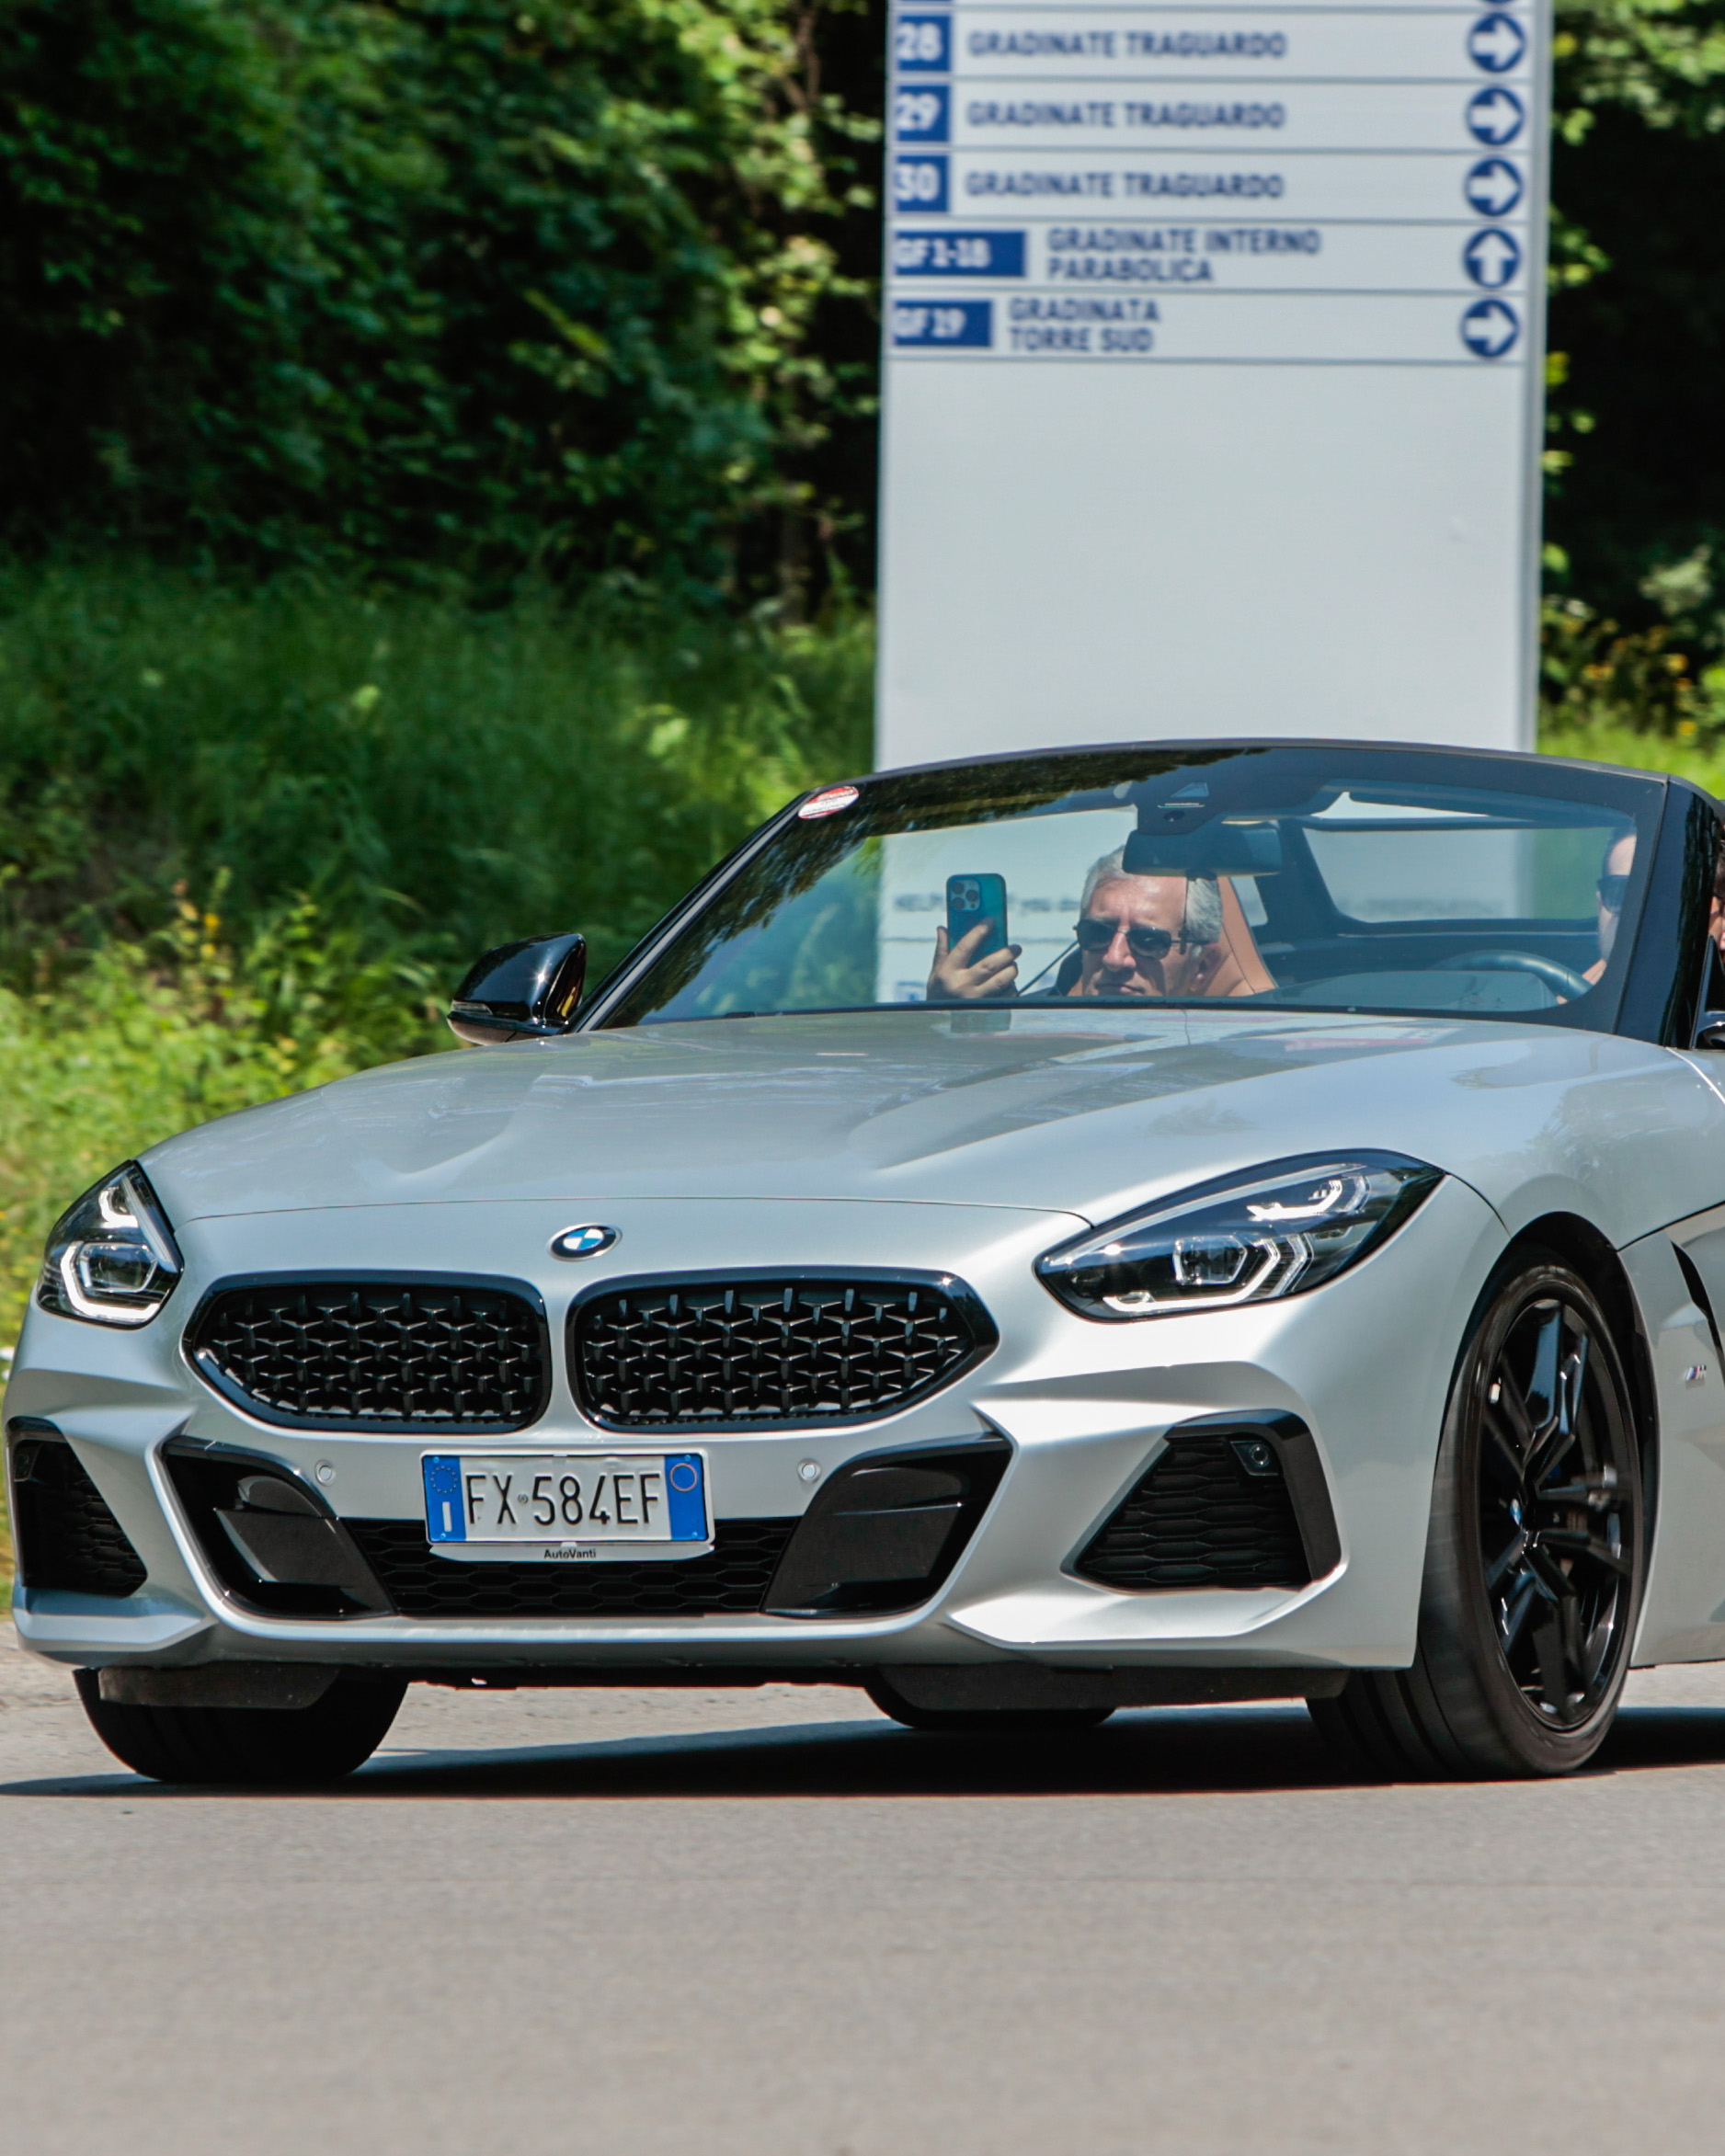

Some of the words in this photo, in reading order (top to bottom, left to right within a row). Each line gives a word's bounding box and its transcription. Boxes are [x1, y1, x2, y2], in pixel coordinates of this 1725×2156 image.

[896, 22, 942, 61] 28
[968, 31, 1116, 58] GRADINATE
[1125, 31, 1287, 59] TRAGUARDO
[896, 94, 941, 131] 29
[968, 101, 1115, 128] GRADINATE
[1124, 101, 1285, 129] TRAGUARDO
[895, 164, 940, 201] 30
[965, 171, 1114, 198] GRADINATE
[1123, 172, 1284, 199] TRAGUARDO
[1048, 229, 1195, 253] GRADINATE
[1205, 229, 1321, 255] INTERNO
[1048, 257, 1213, 281] PARABOLICA
[1011, 298, 1160, 321] GRADINATA
[1009, 327, 1092, 351] TORRE
[1101, 327, 1154, 352] SUD
[543, 1548, 597, 1559] AutoVanti
